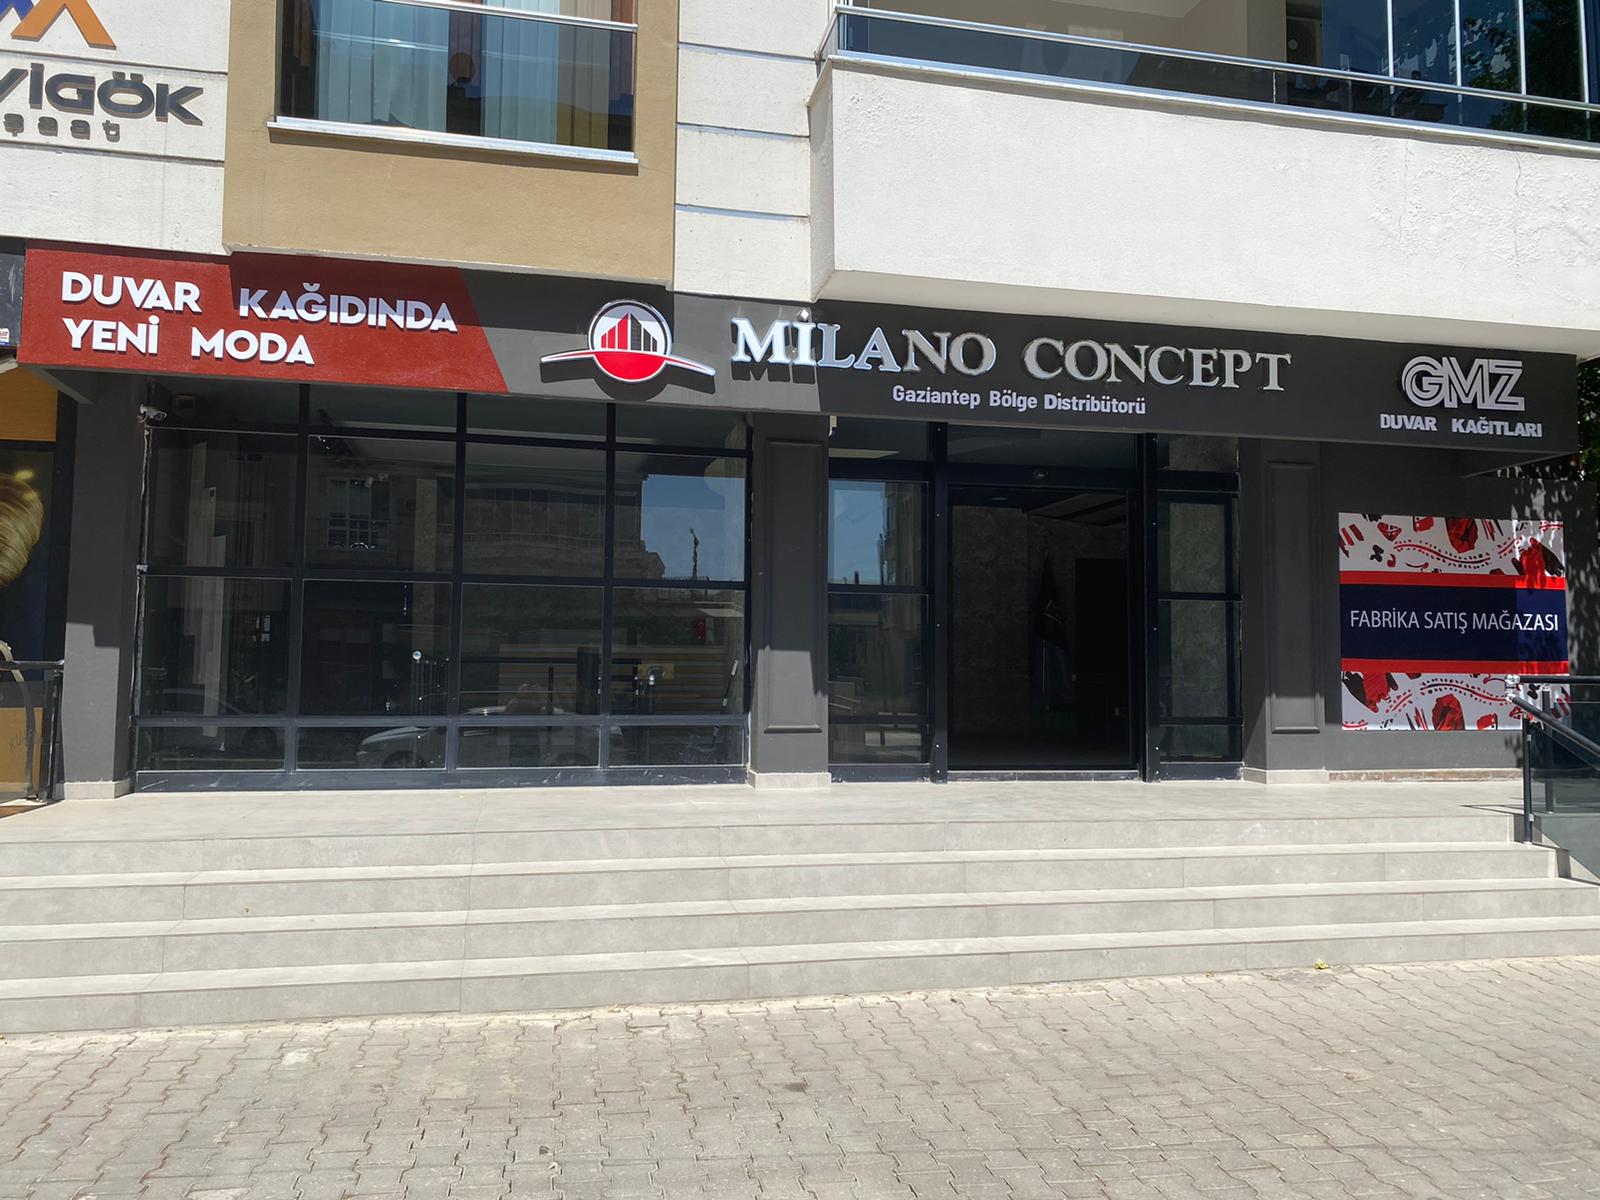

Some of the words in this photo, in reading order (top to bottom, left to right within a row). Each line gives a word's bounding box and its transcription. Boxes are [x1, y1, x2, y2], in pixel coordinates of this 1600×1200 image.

[62, 271, 203, 313] DUVAR
[238, 282, 459, 333] KAĞIDINDA
[62, 315, 160, 355] YENİ
[190, 327, 316, 366] MODA
[730, 309, 998, 376] MİLANO
[1023, 336, 1293, 393] CONCEPT
[892, 384, 981, 409] Gaziantep
[989, 389, 1038, 411] Bölge
[1043, 392, 1147, 415] Distribütorü
[1401, 355, 1526, 411] GMZ
[1379, 413, 1438, 432] DUVAR
[1451, 416, 1543, 438] KAĞITLARI
[1350, 608, 1420, 630] FABRİKA
[1424, 611, 1468, 634] SATIŞ
[1473, 609, 1559, 632] MAĞAZASI
